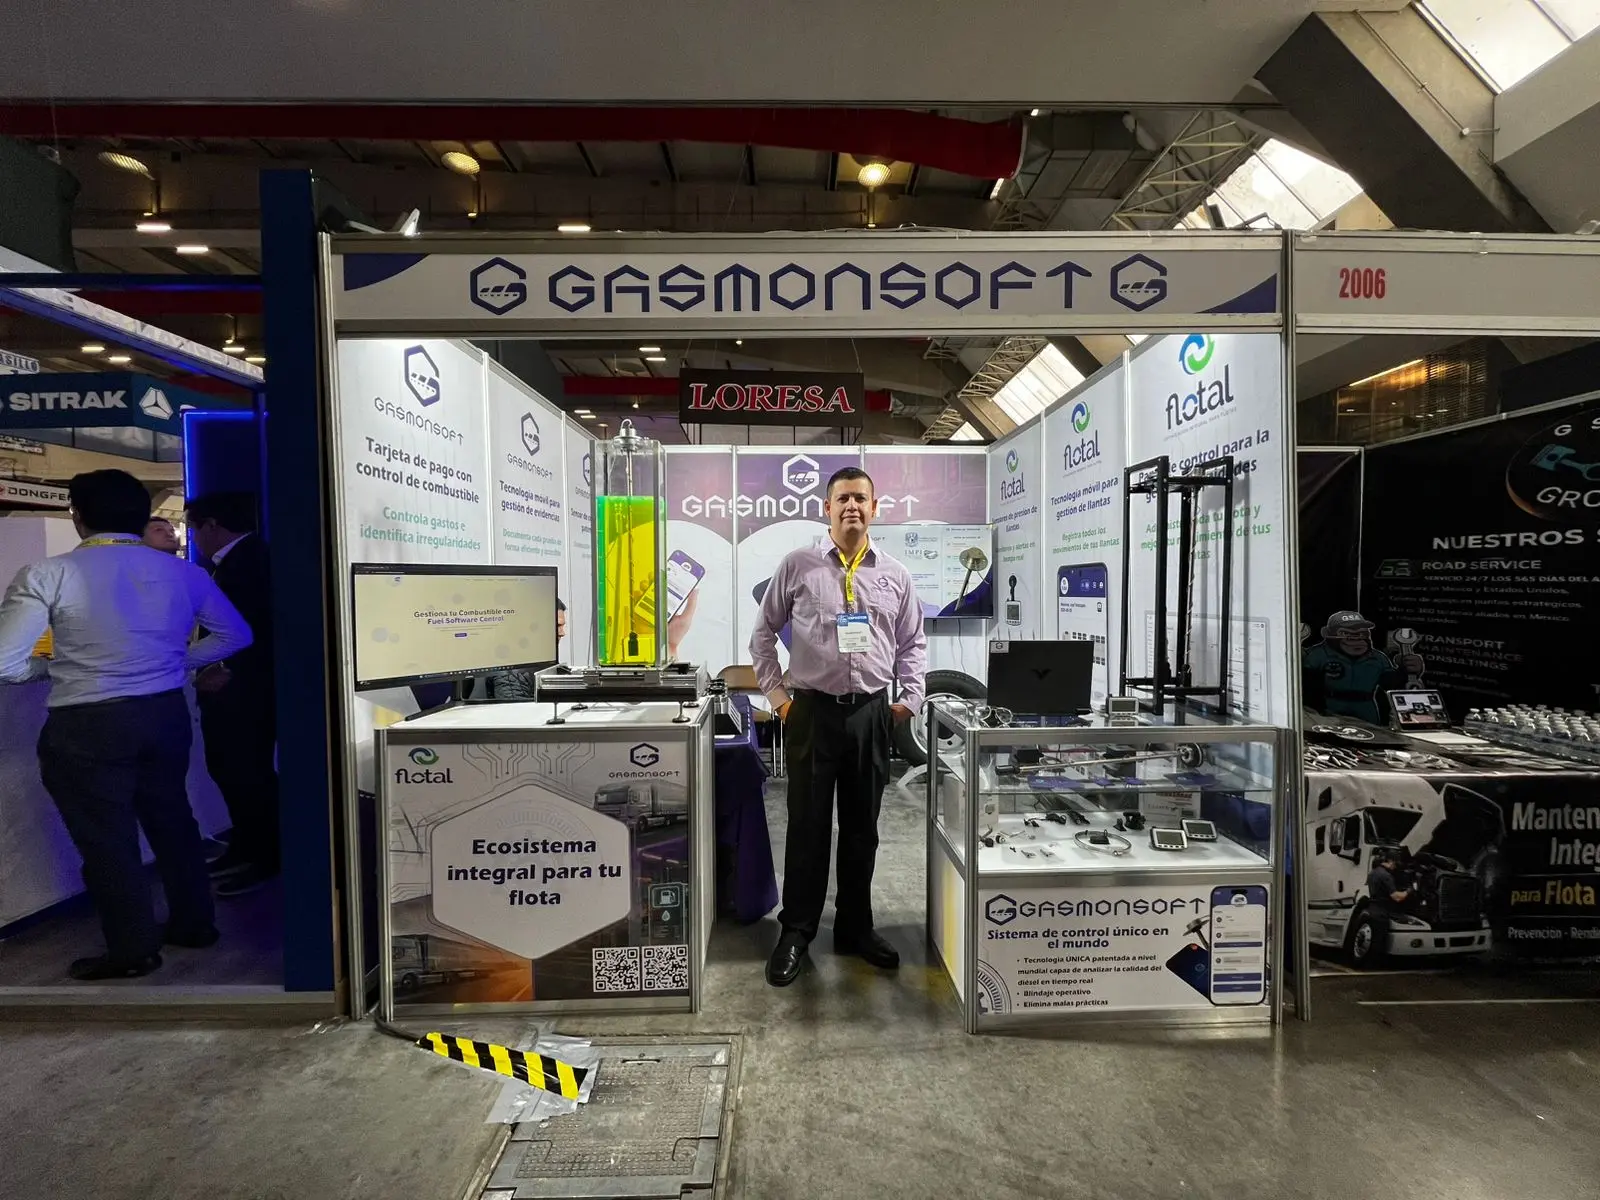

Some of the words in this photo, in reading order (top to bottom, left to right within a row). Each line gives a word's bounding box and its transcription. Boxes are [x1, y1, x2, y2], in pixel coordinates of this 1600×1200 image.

[548, 260, 1092, 313] GASMONSOFT
[1339, 268, 1385, 299] 2006
[9, 390, 127, 411] SITRAK
[688, 382, 855, 414] LORESA
[1165, 364, 1234, 430] flotal
[374, 396, 464, 447] GASMONSOFT
[365, 436, 410, 463] Tarjeta
[413, 453, 427, 469] de
[429, 460, 454, 480] pago
[456, 468, 472, 483] con
[1063, 429, 1101, 471] flotal
[1179, 444, 1219, 472] control
[1222, 434, 1252, 457] para
[1257, 429, 1270, 446] la
[356, 461, 403, 485] control
[406, 472, 420, 489] de
[422, 476, 479, 504] combustible
[1000, 472, 1025, 501] flotal
[1082, 481, 1101, 496] móvil
[1101, 477, 1119, 493] para
[501, 499, 525, 516] gestión
[526, 506, 534, 516] de
[535, 507, 560, 523] evidencias
[681, 494, 919, 519] GASMONFT
[1079, 503, 1086, 513] de
[1087, 496, 1111, 511] llantas
[1254, 505, 1261, 519] y
[383, 506, 428, 526] Controla
[430, 515, 459, 532] gastos
[460, 522, 466, 531] e
[360, 524, 413, 544] identifica
[416, 531, 481, 551] irregularidades
[1082, 528, 1097, 538] todos
[1098, 526, 1106, 534] los
[1236, 525, 1249, 537] de
[1252, 524, 1272, 536] tus
[1432, 528, 1585, 550] NUESTROS
[1083, 541, 1089, 550] de
[1099, 537, 1120, 547] llantas
[1422, 561, 1466, 570] ROAD
[1470, 560, 1542, 570] SERVICE
[1417, 633, 1506, 650] TRANSPORT
[1426, 654, 1509, 671] ONSULTINGS
[394, 768, 454, 785] flotal
[472, 838, 597, 855] Ecosistema
[447, 864, 536, 884] integral
[542, 867, 592, 883] para
[599, 864, 621, 878] tu
[509, 889, 562, 905] flota
[1510, 889, 1541, 906] para
[1545, 879, 1596, 906] Flota
[1019, 897, 1206, 919] GASMONSOFT
[987, 928, 1037, 940] Sistema
[1042, 928, 1059, 938] de
[1062, 927, 1110, 938] control
[1113, 926, 1149, 937] único
[1153, 928, 1169, 936] en
[1047, 939, 1059, 949] el
[1062, 938, 1109, 949] mundo
[1024, 956, 1064, 965] Tecnología
[1092, 955, 1130, 963] patentada
[1018, 978, 1039, 986] diésel
[1052, 978, 1077, 986] tiempo
[1024, 989, 1054, 998] Blindaje
[1055, 988, 1091, 997] operativo
[1075, 999, 1108, 1008] prácticas
